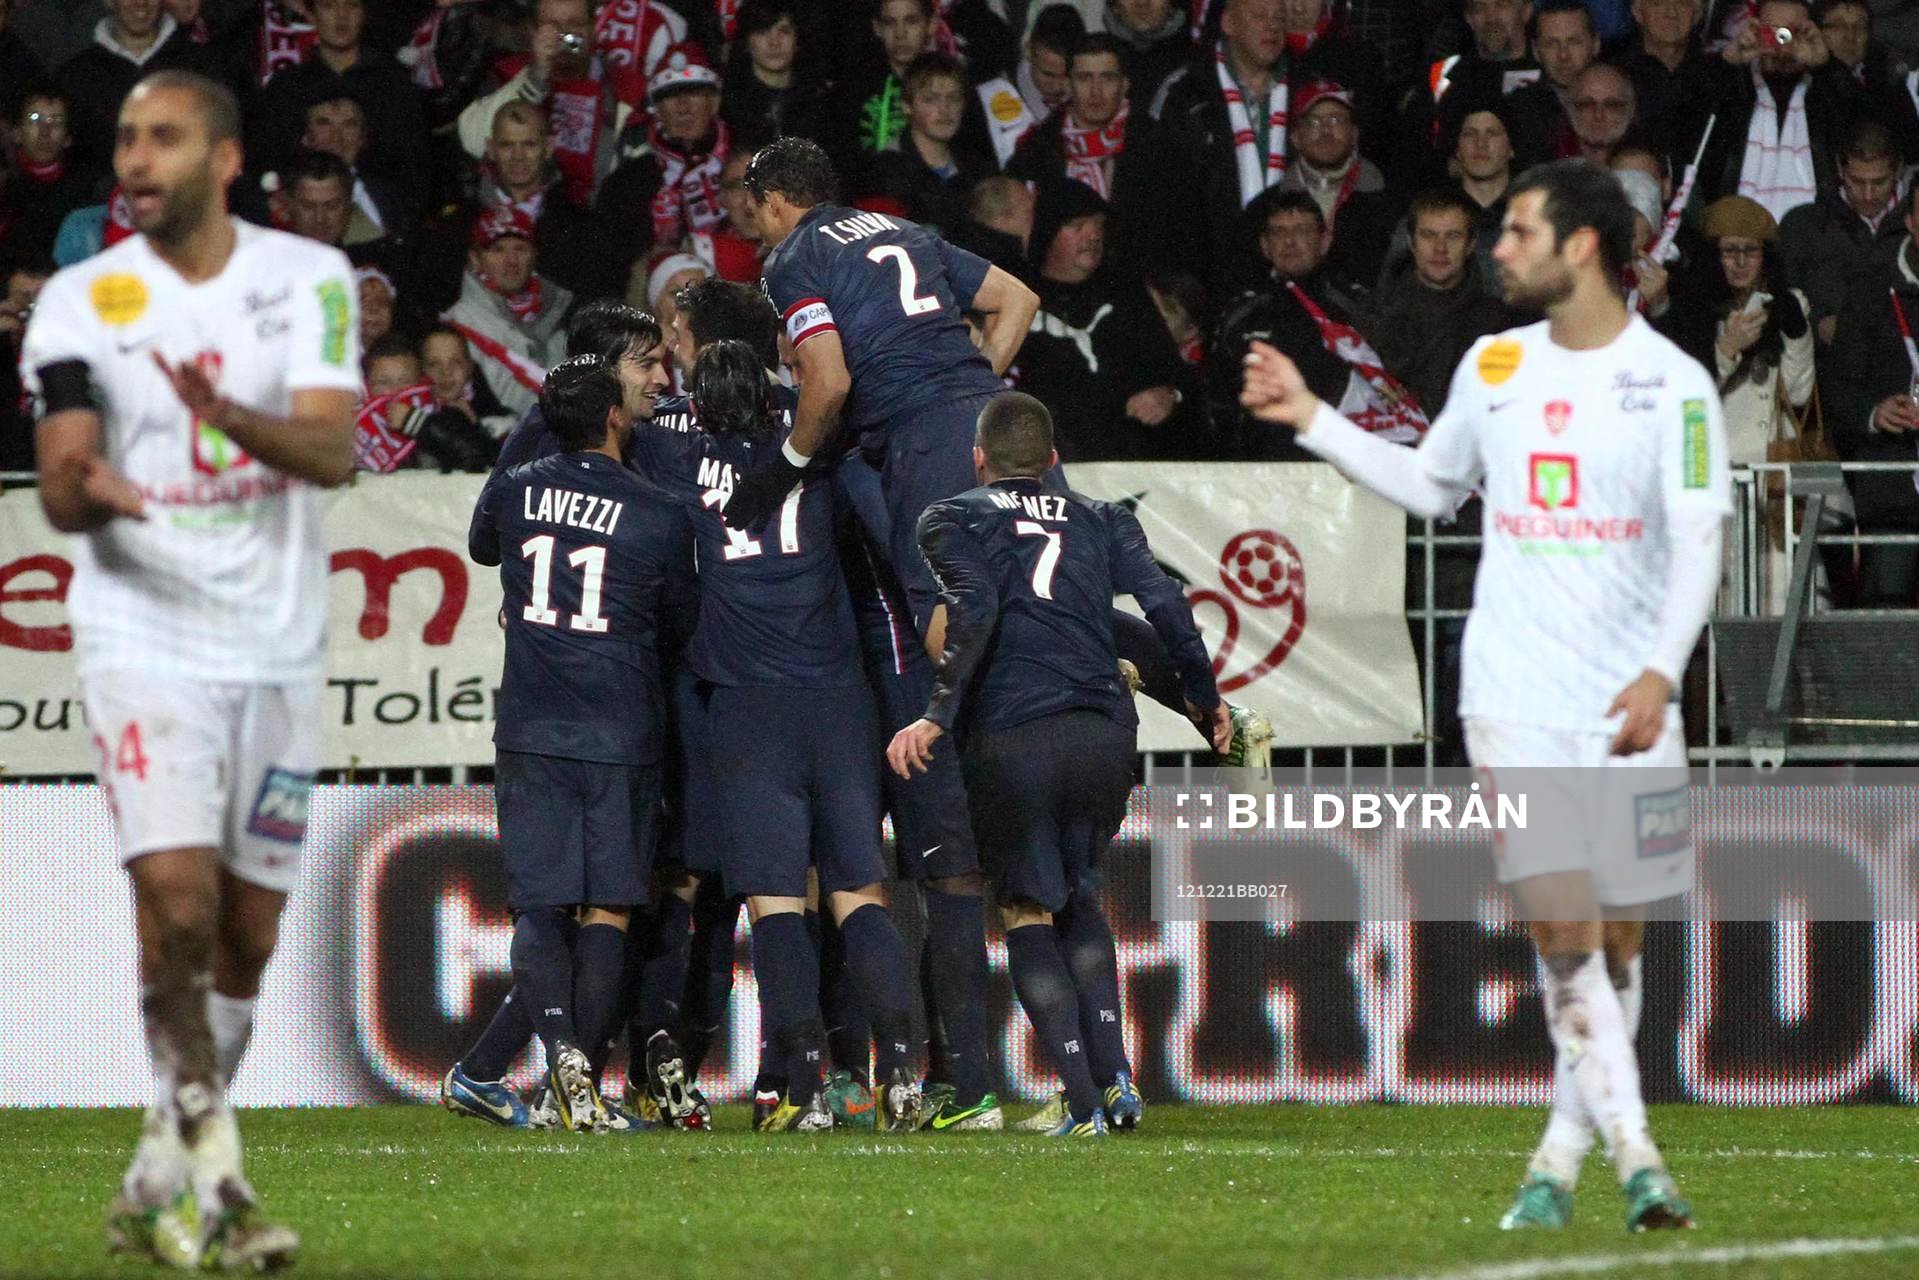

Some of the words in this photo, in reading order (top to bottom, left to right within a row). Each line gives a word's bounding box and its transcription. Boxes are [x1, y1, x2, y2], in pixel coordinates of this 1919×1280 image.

[819, 212, 900, 245] T.SILVA
[866, 244, 942, 317] 2
[524, 486, 623, 536] LAVEZZI
[521, 535, 609, 633] 11
[1016, 520, 1061, 600] 7
